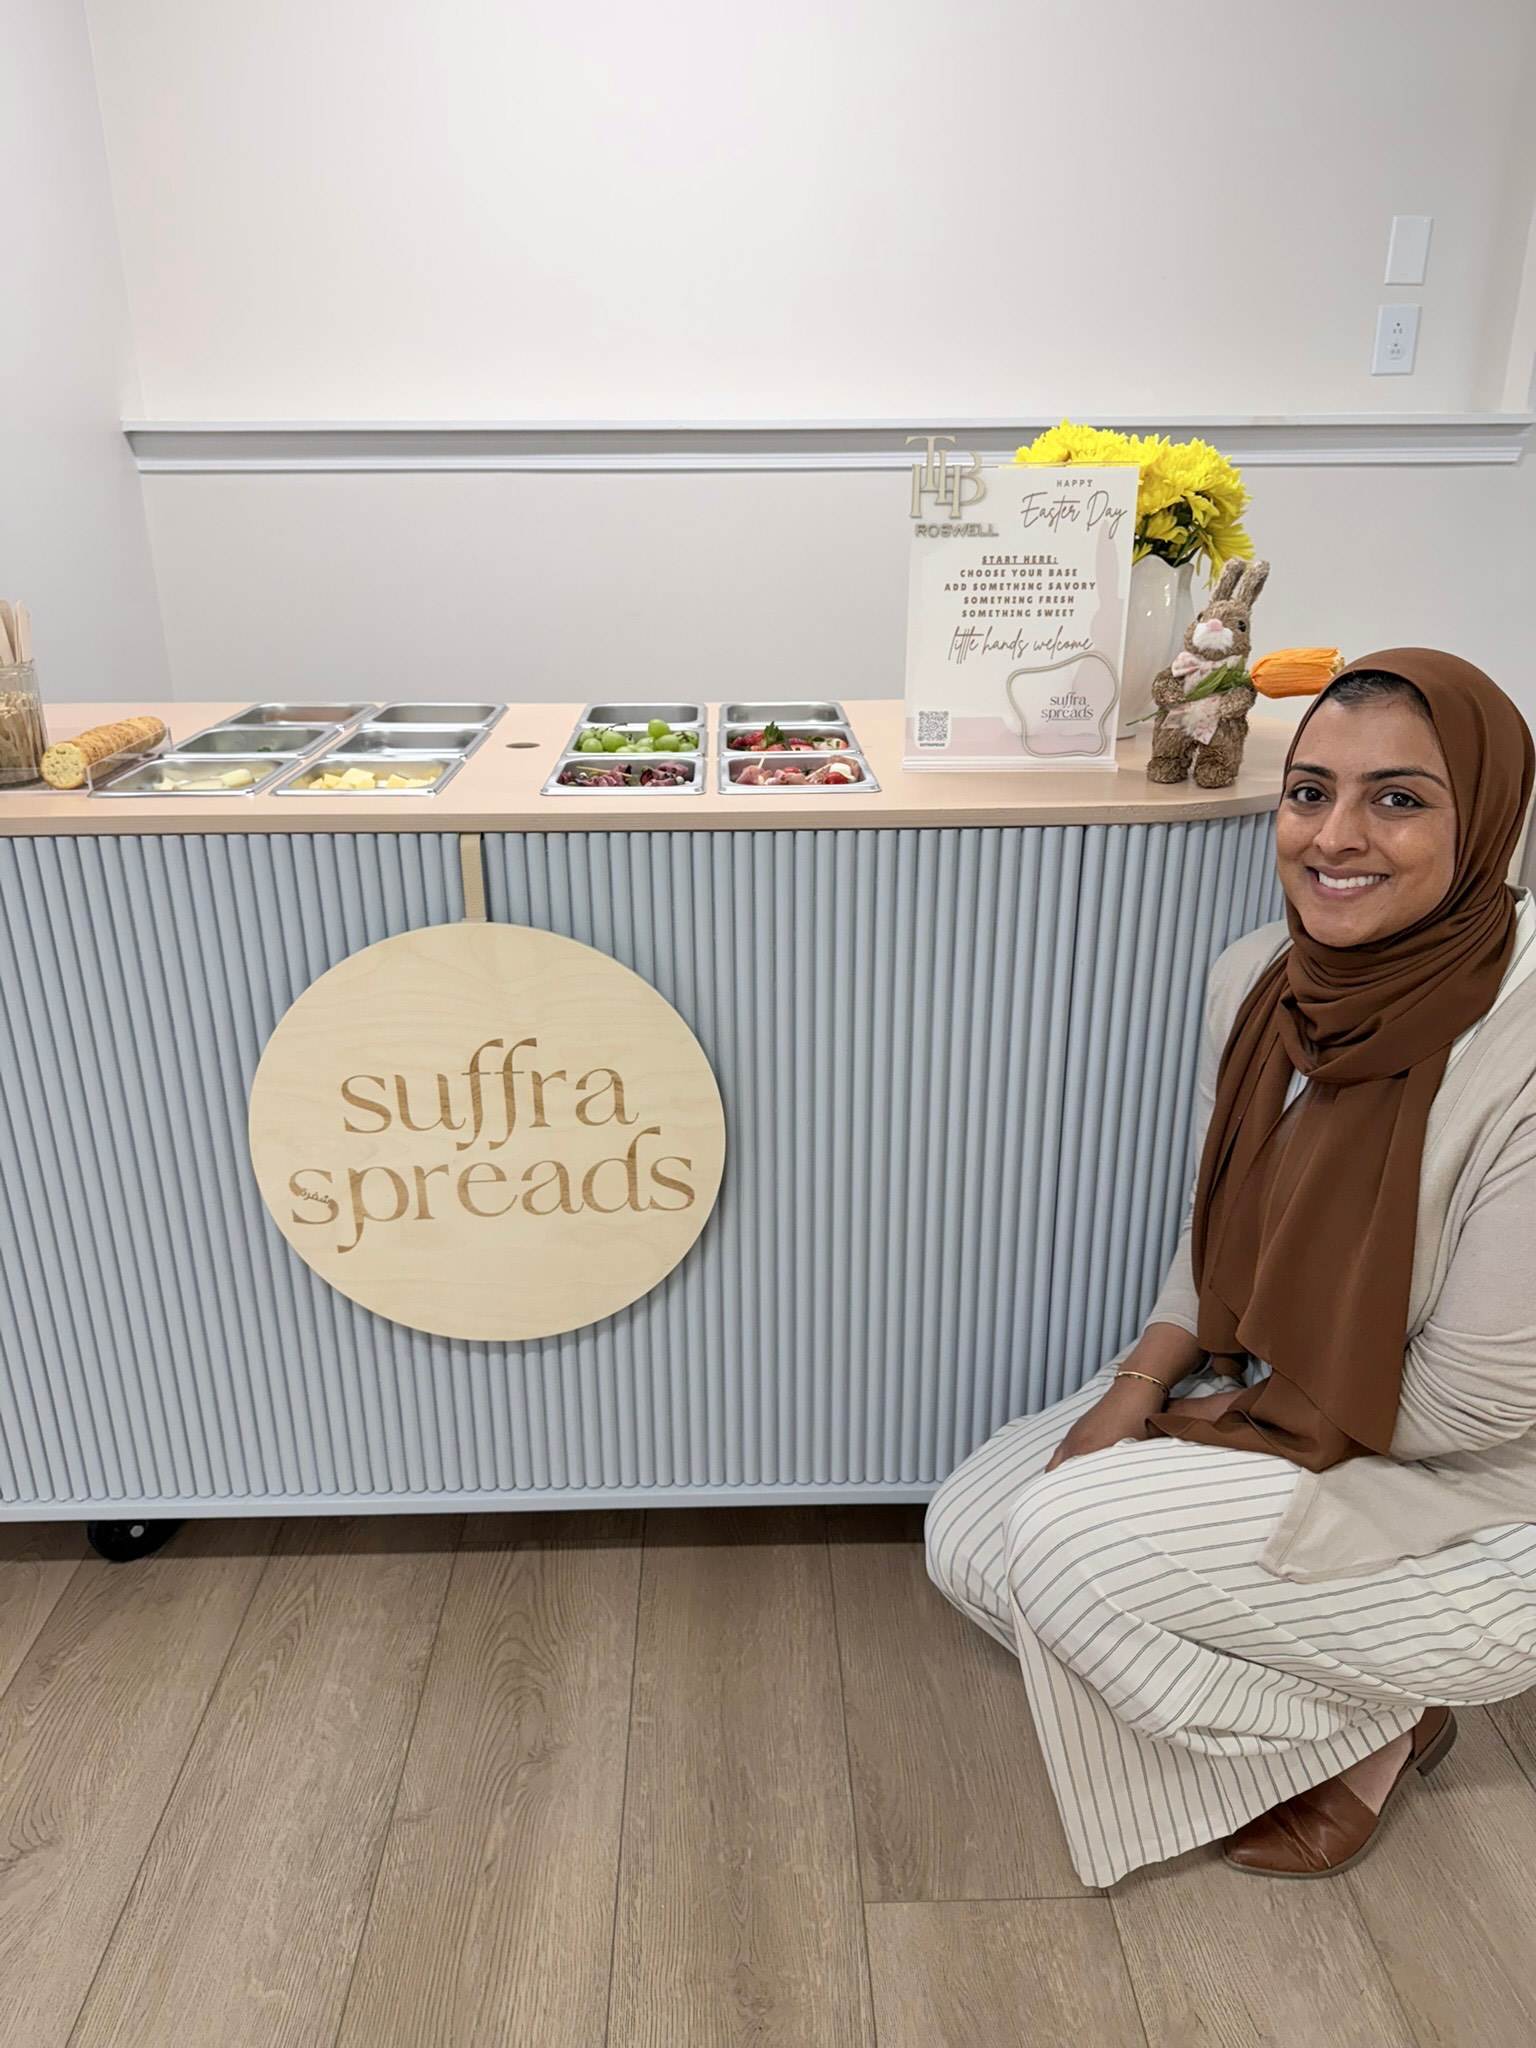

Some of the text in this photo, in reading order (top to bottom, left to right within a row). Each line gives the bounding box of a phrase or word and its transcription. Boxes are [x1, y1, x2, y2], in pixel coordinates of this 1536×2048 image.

[1056, 480, 1093, 488] HAPPY
[1020, 490, 1128, 539] Easter Day
[915, 523, 999, 537] ROSWELL
[982, 555, 1059, 565] START HERE:
[960, 568, 1078, 577] CHOOSE YOUR BASE
[944, 582, 1096, 591] ADD SOMETHING SAVORY
[963, 595, 1074, 604] SOMETHING FRESH
[961, 609, 1075, 617] SOMETHING SWEET
[948, 625, 1093, 664] little hands welcome
[1050, 691, 1087, 708] suffra
[1041, 704, 1094, 722] spreads
[341, 1037, 639, 1151] suffra
[289, 1126, 696, 1253] spreads
